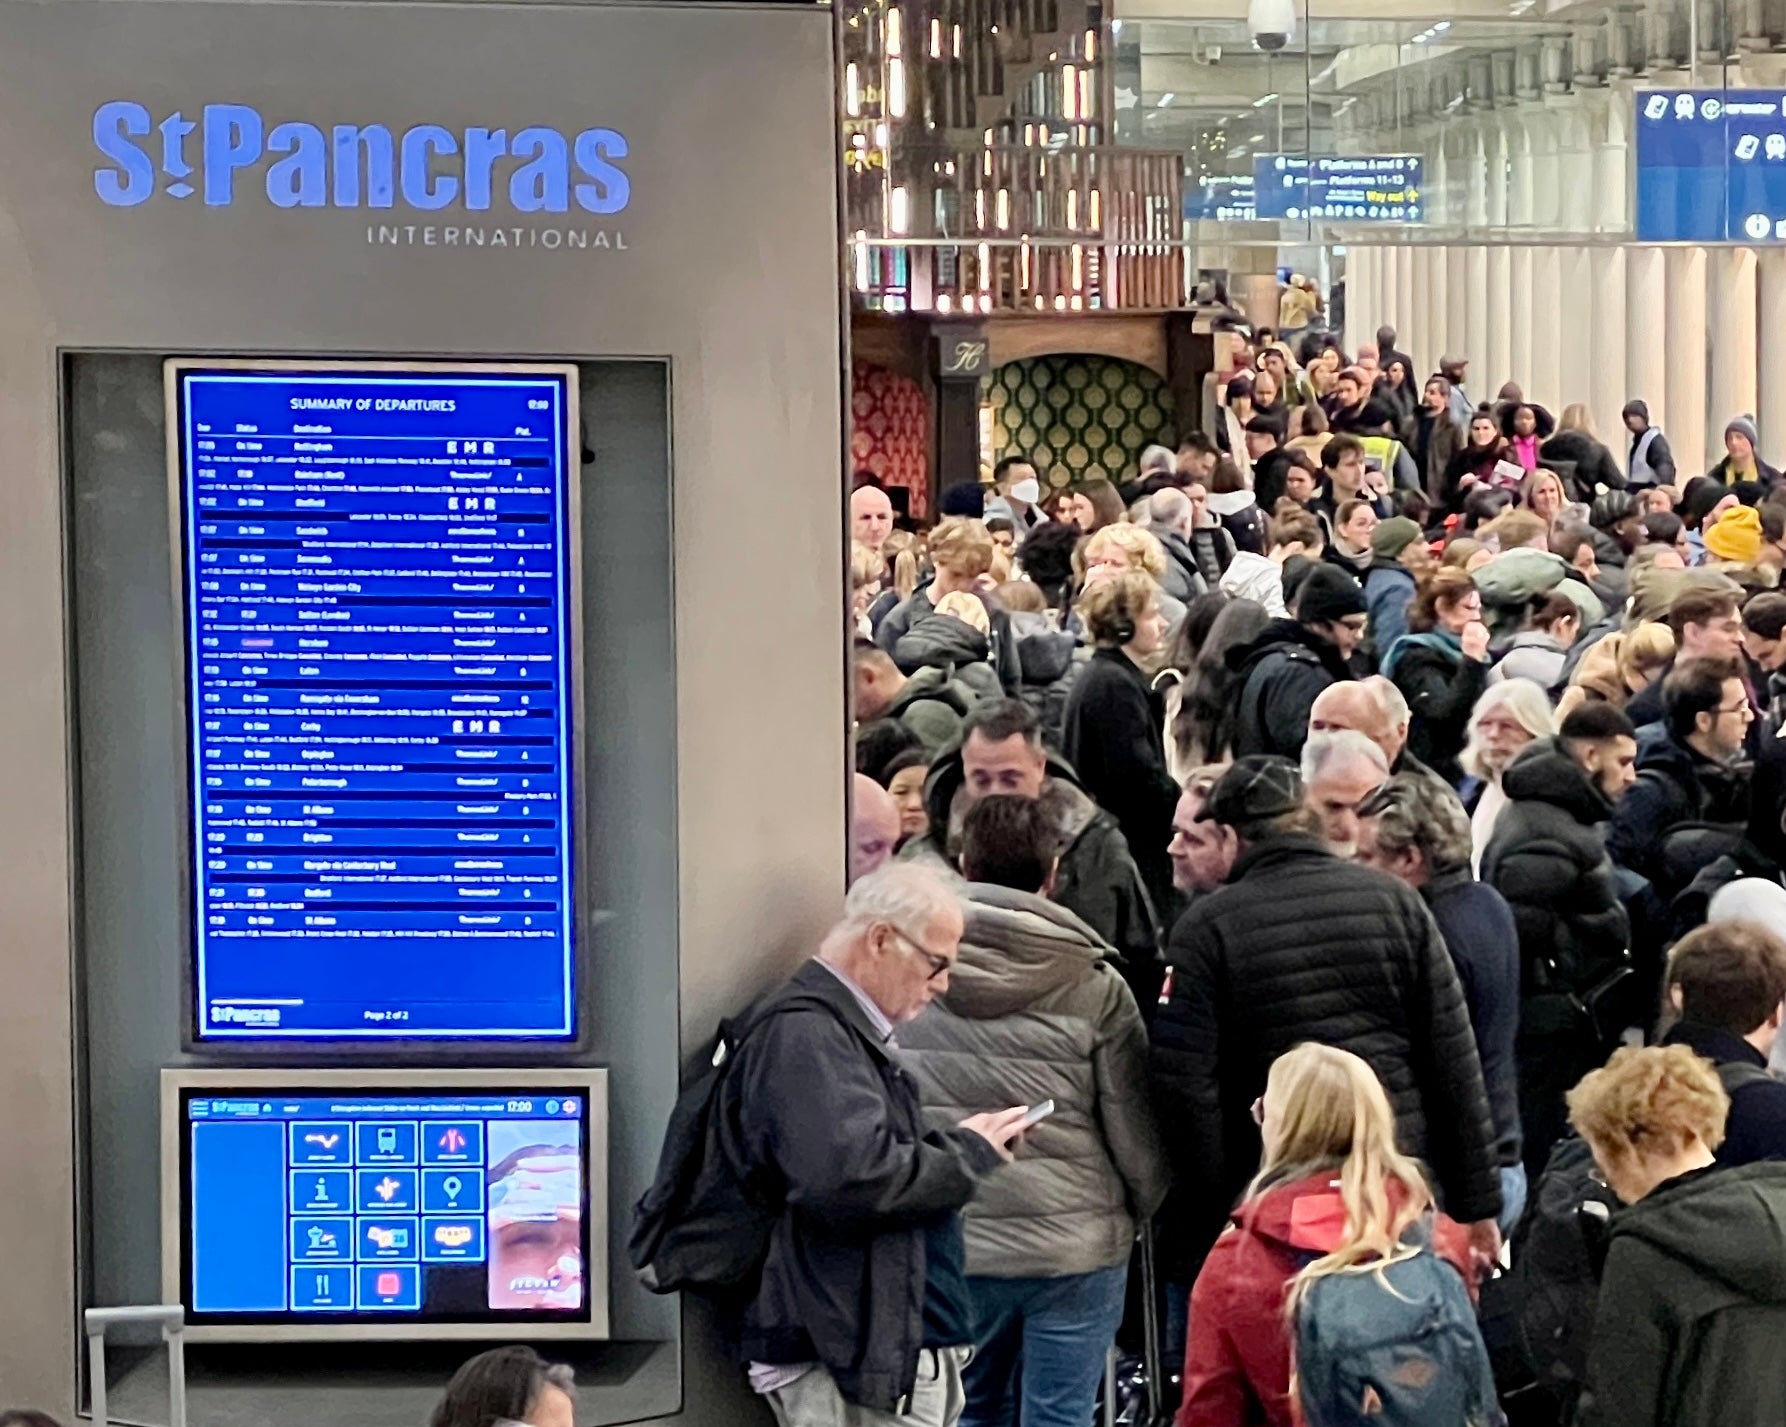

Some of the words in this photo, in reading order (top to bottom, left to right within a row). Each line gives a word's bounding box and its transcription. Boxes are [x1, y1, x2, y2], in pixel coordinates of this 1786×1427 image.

[366, 226, 629, 250] INTERNATIONAL
[290, 398, 352, 410] SUMMARY
[355, 399, 372, 411] OF
[375, 400, 456, 413] DEPARTURES
